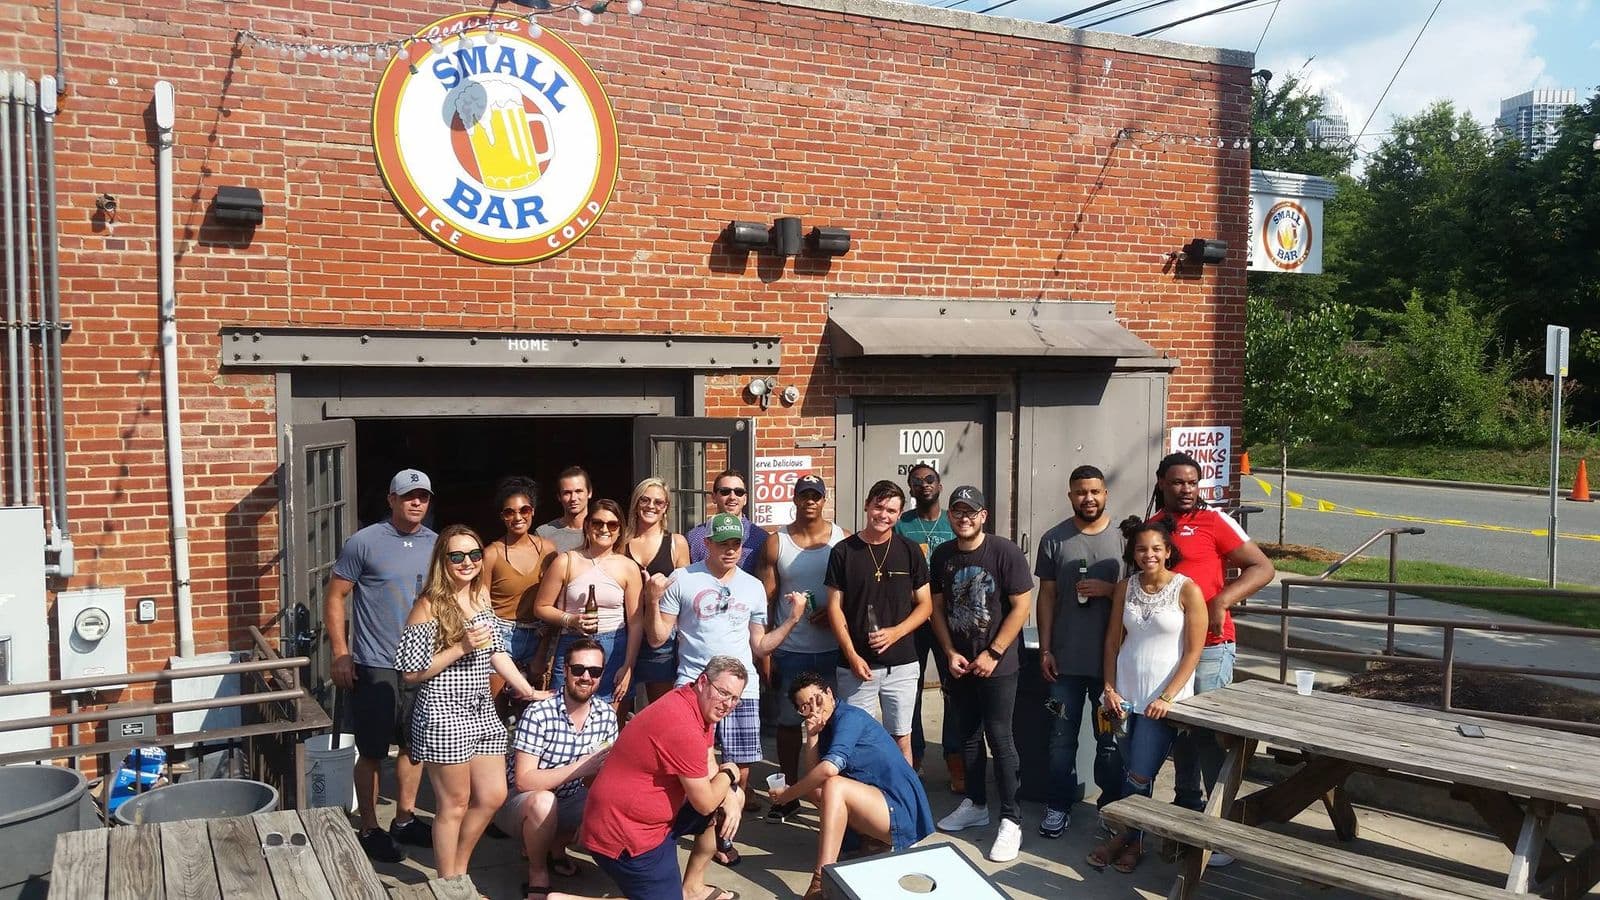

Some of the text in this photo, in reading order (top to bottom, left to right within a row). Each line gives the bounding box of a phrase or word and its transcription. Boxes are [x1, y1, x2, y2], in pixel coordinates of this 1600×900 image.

[432, 45, 569, 113] SMALL
[442, 178, 548, 229] BAR
[416, 201, 600, 248] ICE COLD
[1273, 210, 1301, 226] SMALL
[1277, 249, 1298, 260] BAR
[903, 430, 944, 453] 1000
[1178, 432, 1224, 447] CHEAP
[773, 459, 803, 468] Delicious
[1176, 449, 1227, 463] RINKS
